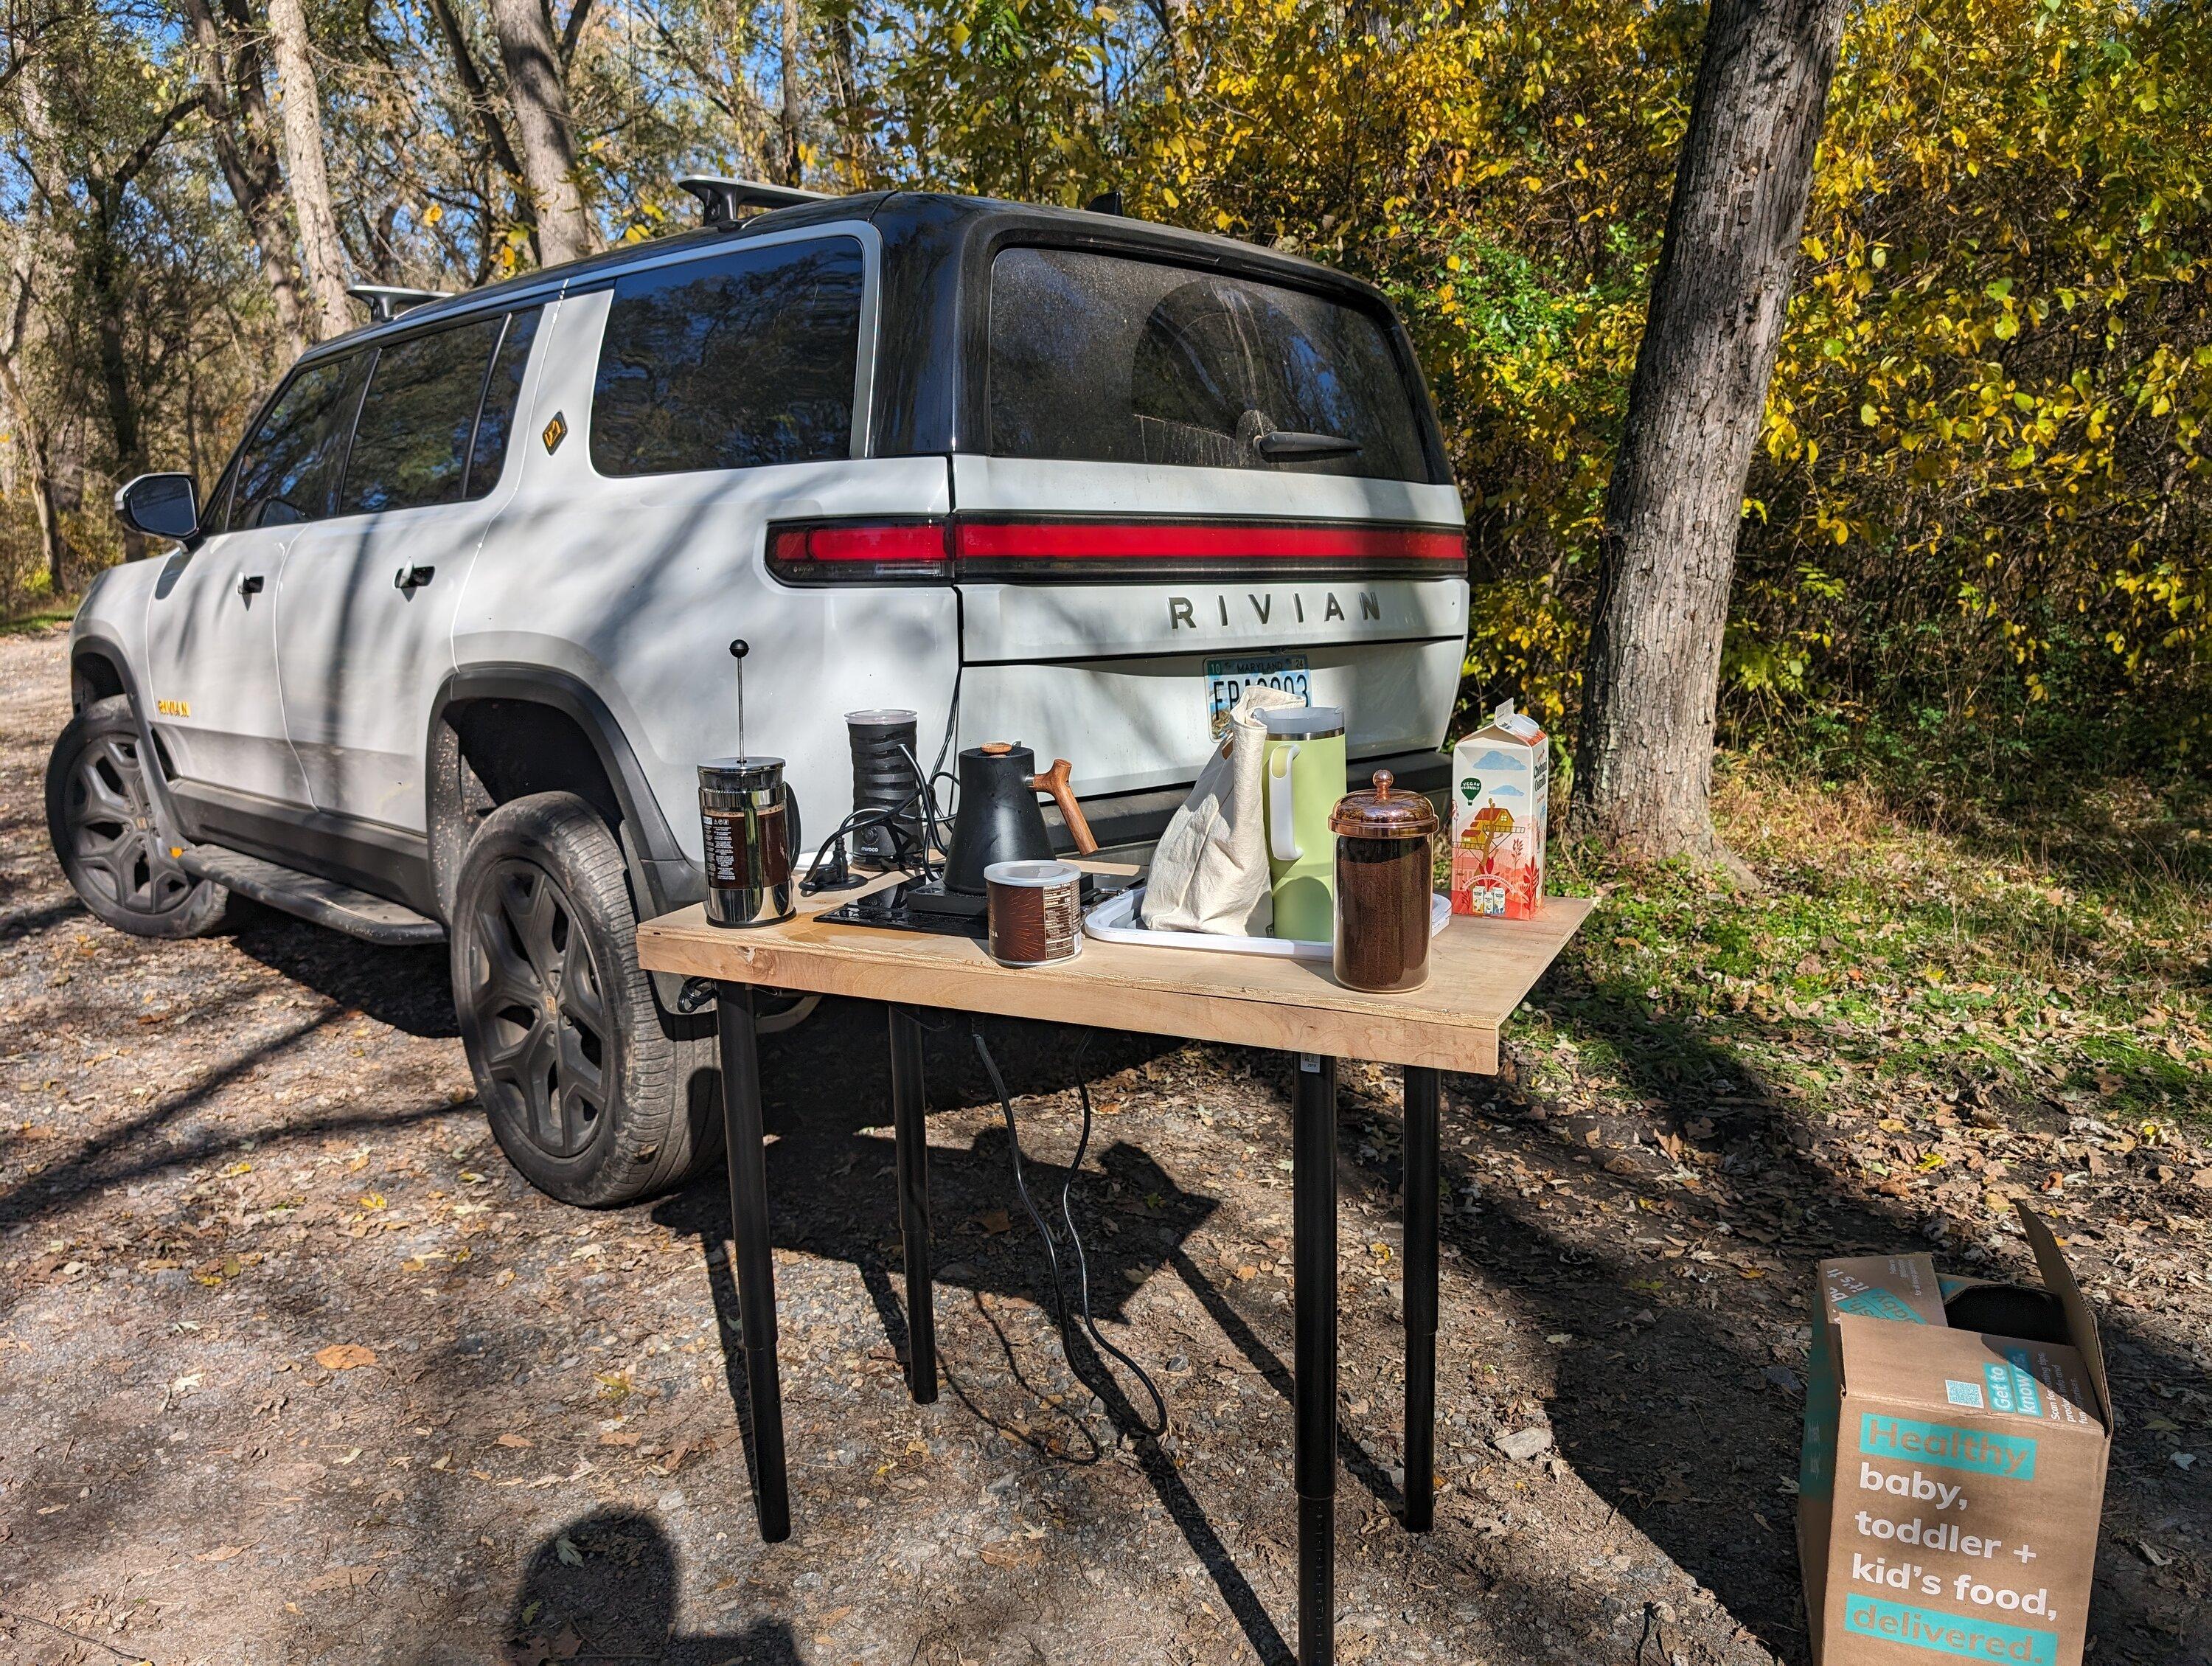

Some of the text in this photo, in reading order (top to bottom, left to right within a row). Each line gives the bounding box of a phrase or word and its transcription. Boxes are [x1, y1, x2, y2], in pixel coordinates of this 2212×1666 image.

[1167, 591, 1380, 629] RIVIAN
[1211, 664, 1220, 674] 10
[1237, 661, 1282, 673] MARYLAND
[1295, 659, 1303, 668] 24
[1990, 1367, 2011, 1410] Get to
[2015, 1374, 2037, 1414] know
[2045, 1389, 2055, 1401] for
[2050, 1402, 2061, 1420] Scan
[2079, 1412, 2088, 1424] fun
[1869, 1419, 2029, 1474] Healthy
[1860, 1462, 1968, 1510] baby,
[1854, 1510, 2037, 1563] toddler +
[1852, 1553, 2057, 1622] kid's food,
[1853, 1604, 2042, 1663] delivered.
